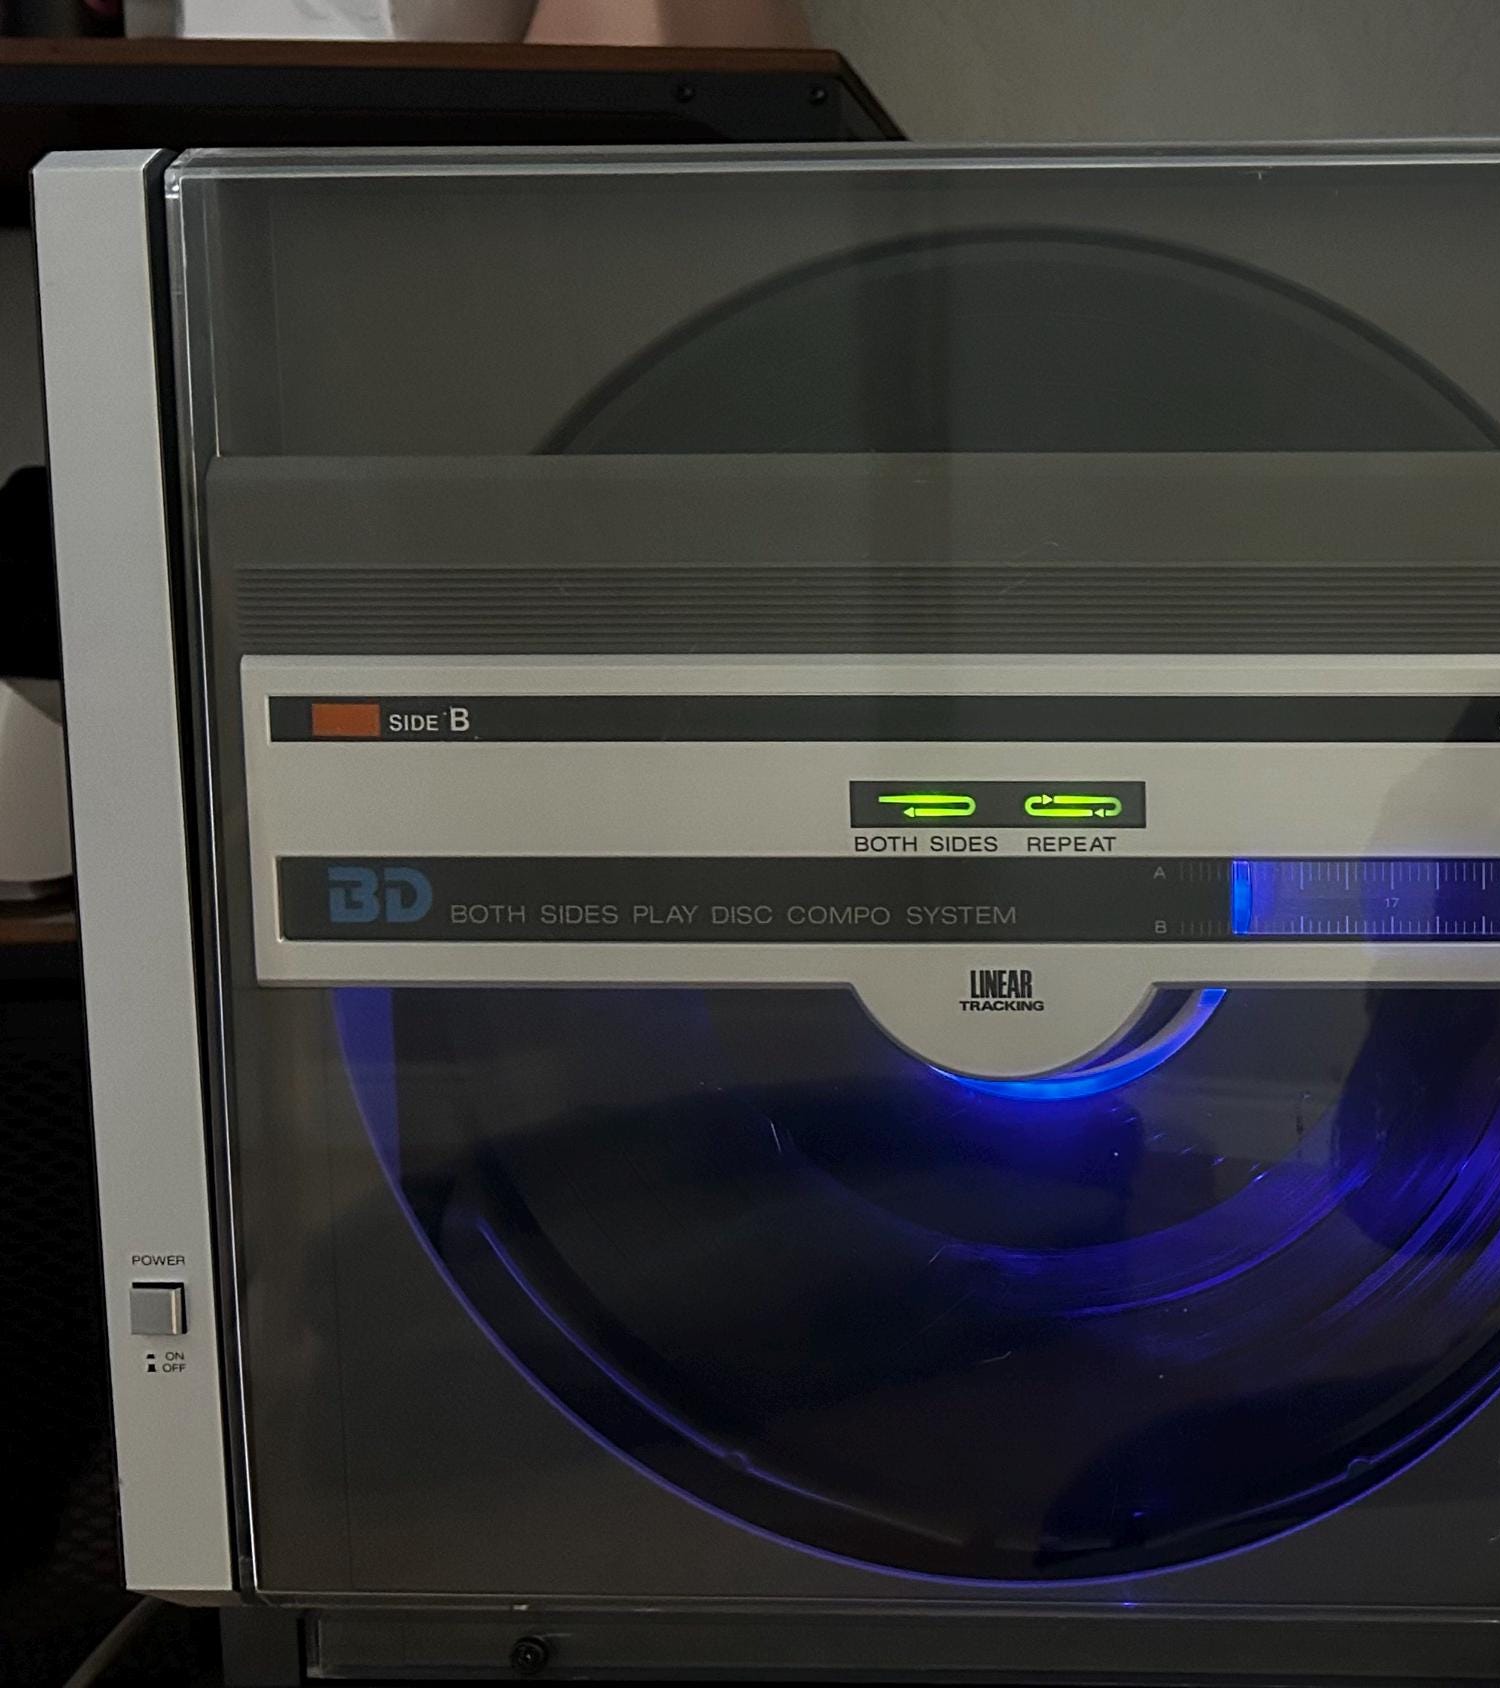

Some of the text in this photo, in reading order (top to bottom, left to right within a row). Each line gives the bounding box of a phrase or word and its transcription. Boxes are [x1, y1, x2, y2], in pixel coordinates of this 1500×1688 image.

[389, 707, 470, 732] SIDE B
[854, 836, 998, 852] BOTH SIDES
[1027, 837, 1117, 852] REPEAT
[1153, 866, 1166, 879] A
[328, 867, 433, 923] BD
[1385, 898, 1399, 908] 17
[451, 905, 1017, 925] BOTH SIDES PLAY DISC COMPO SYSTEM
[1155, 921, 1167, 934] B
[970, 970, 1032, 999] LINEAR
[960, 1001, 1044, 1012] TRACKING
[132, 1255, 186, 1266] POWER
[165, 1352, 184, 1361] ON
[162, 1363, 186, 1373] OFF
